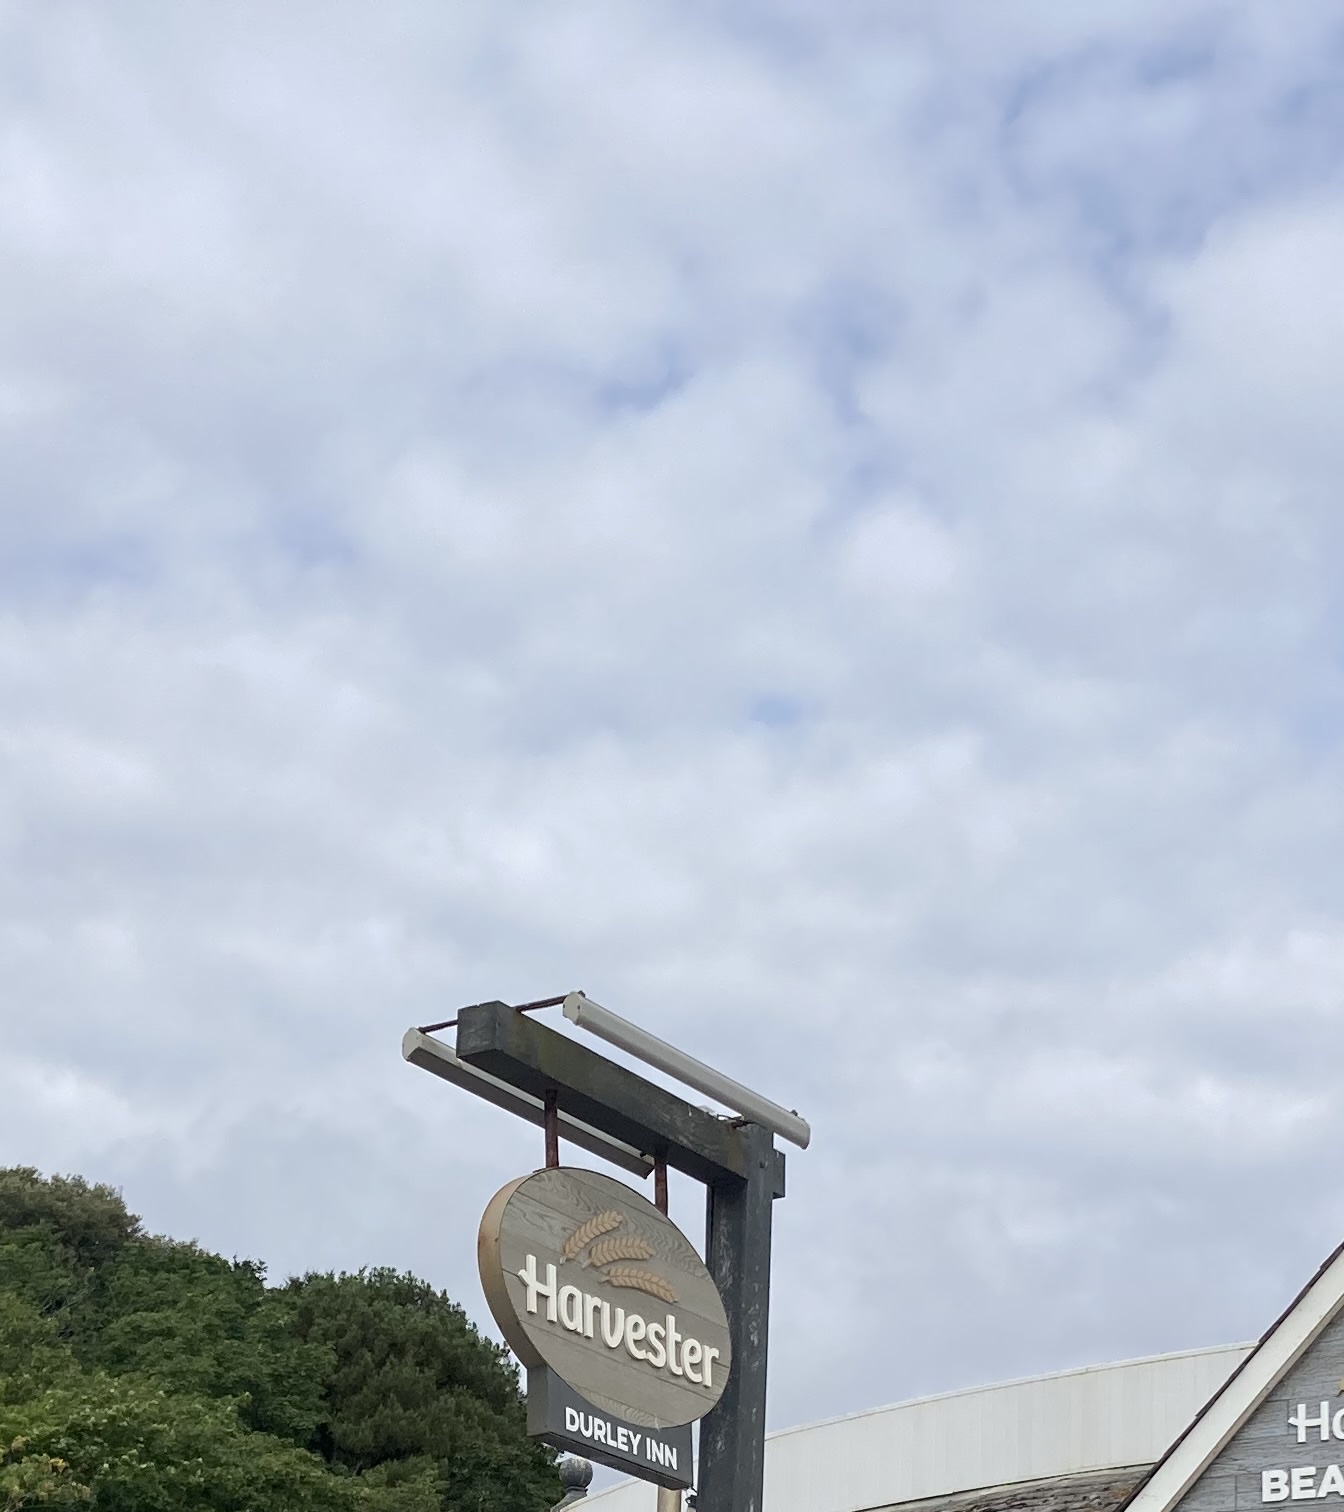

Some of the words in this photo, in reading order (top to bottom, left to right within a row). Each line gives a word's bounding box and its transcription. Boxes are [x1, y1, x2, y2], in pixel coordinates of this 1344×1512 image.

[517, 1254, 719, 1387] Harvester
[565, 1406, 641, 1456] DURLEY
[645, 1437, 678, 1470] INN
